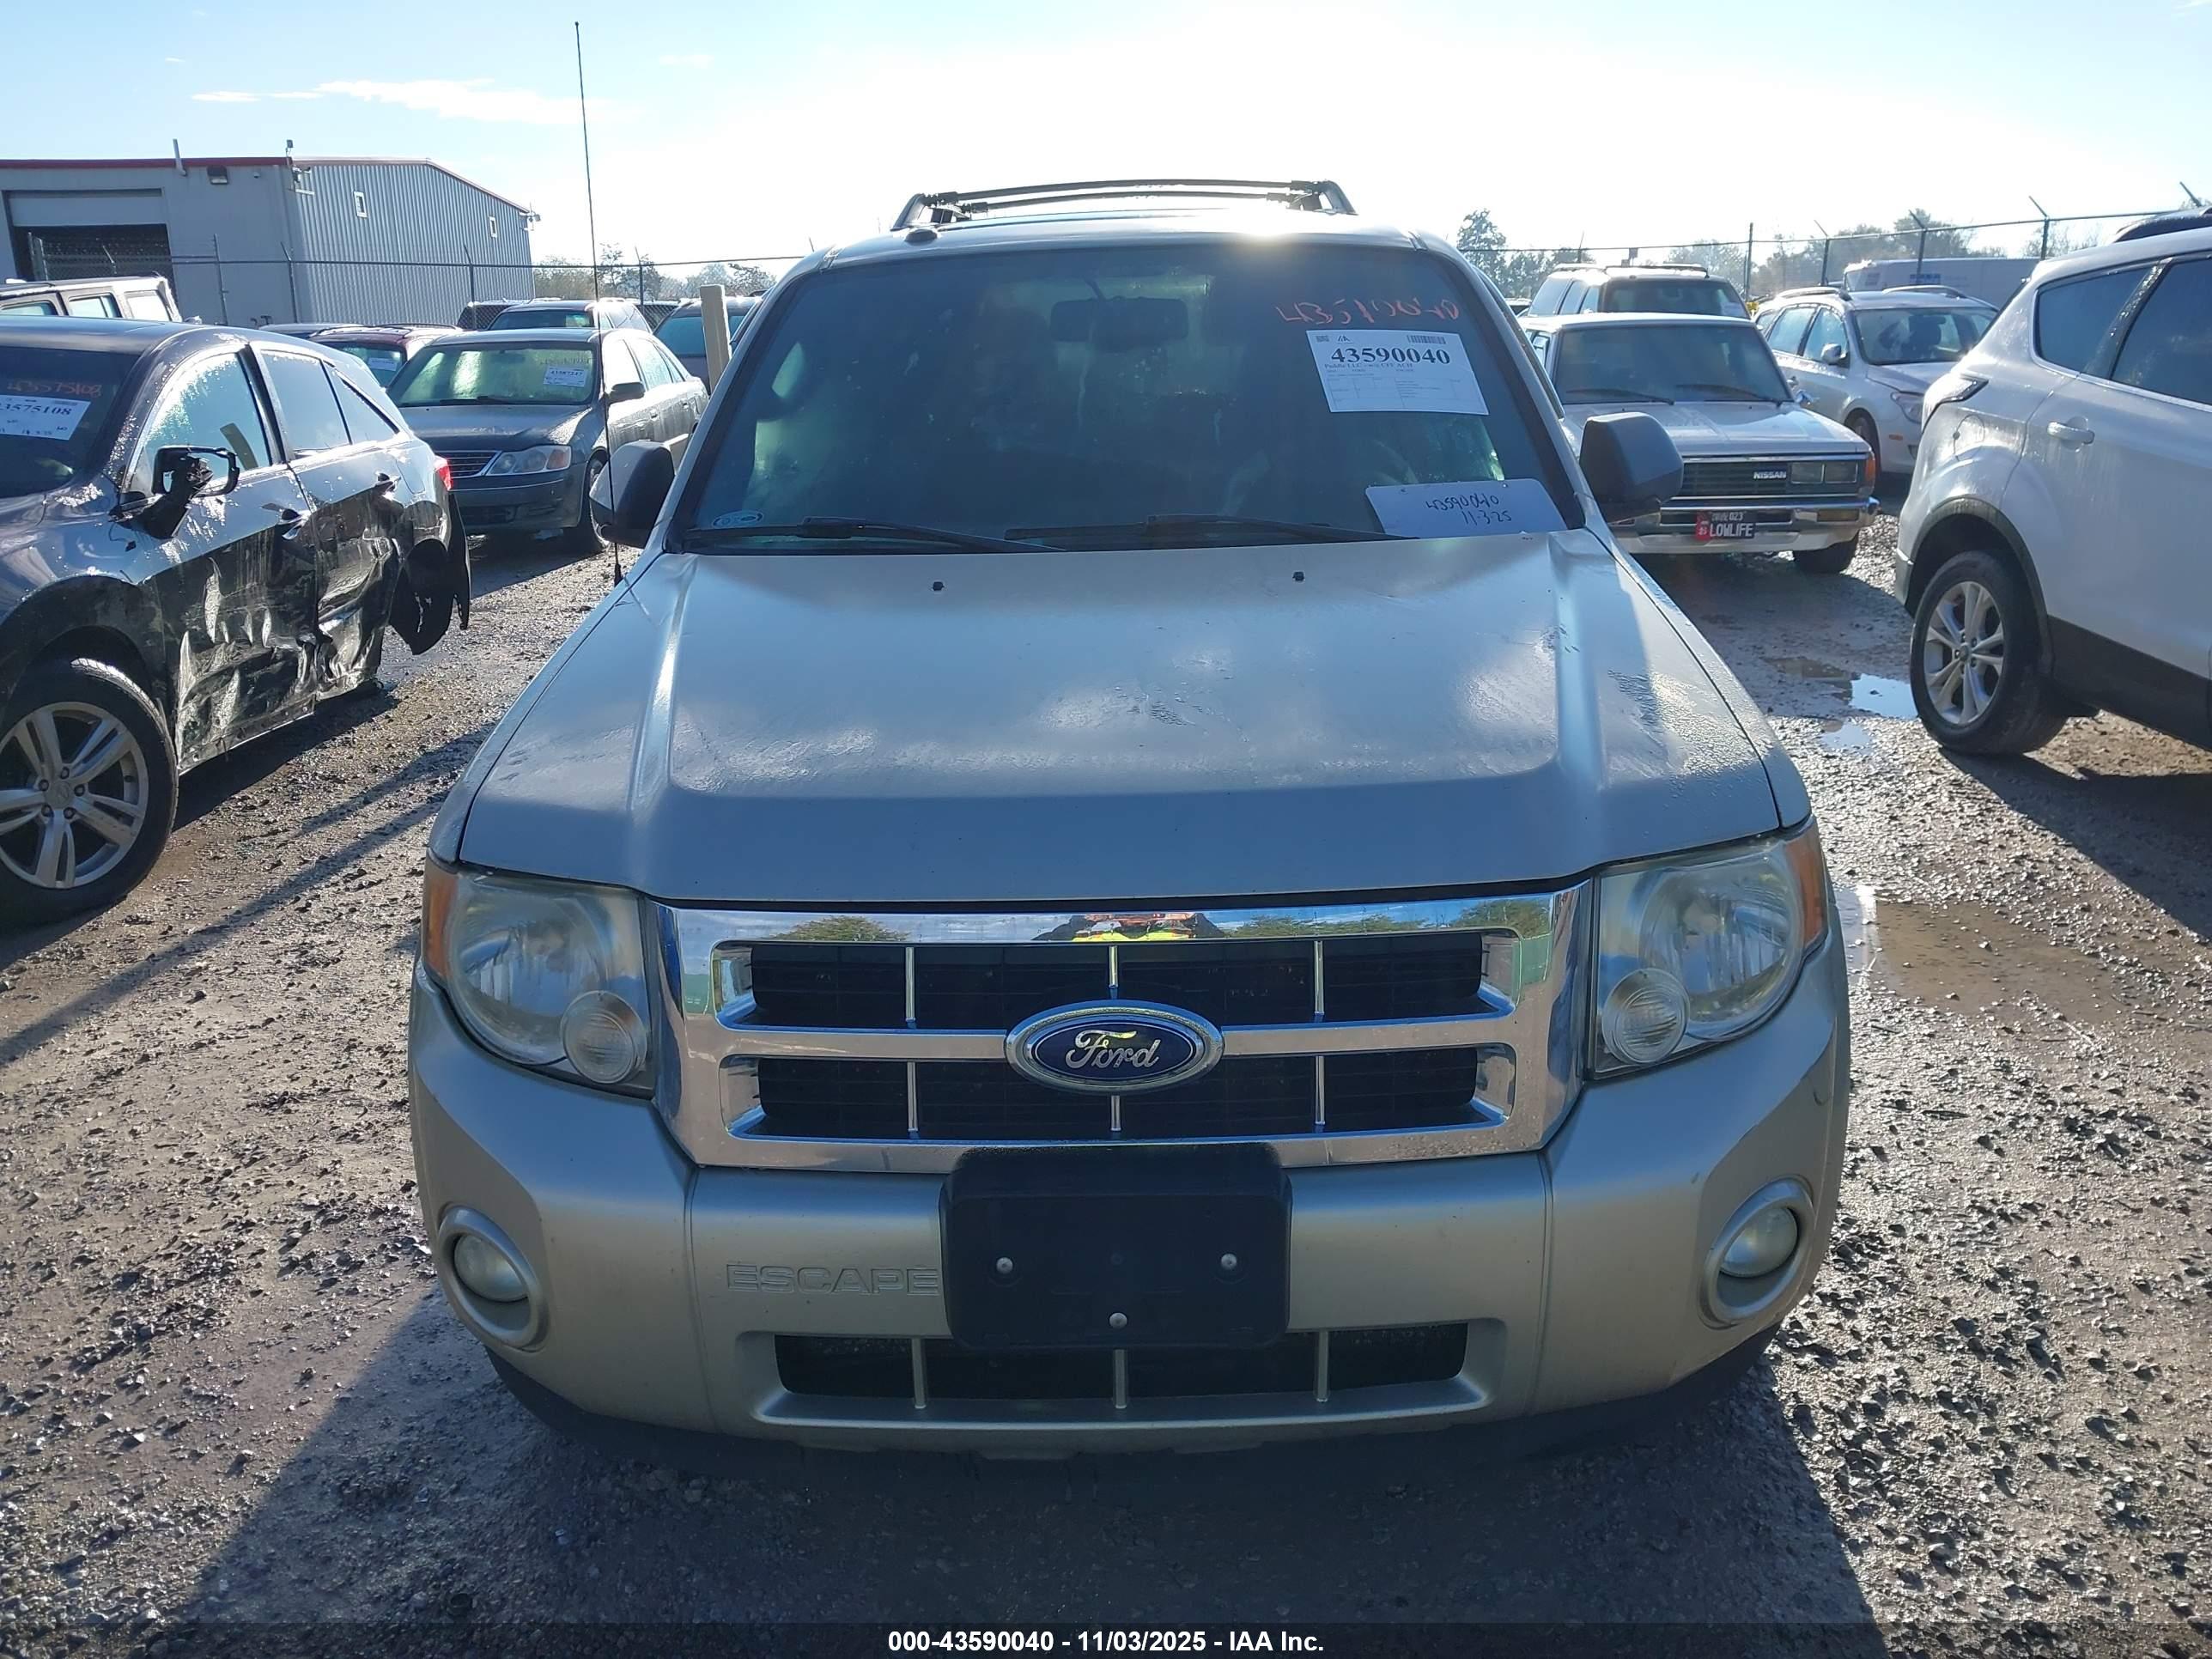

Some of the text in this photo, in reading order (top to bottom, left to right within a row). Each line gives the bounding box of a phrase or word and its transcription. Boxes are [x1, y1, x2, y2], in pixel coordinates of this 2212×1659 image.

[1331, 347, 1450, 365] 43590040
[0, 403, 72, 415] 3575108
[1425, 493, 1499, 511] 43590040
[1710, 522, 1754, 537] LOWLIFE
[1065, 1030, 1161, 1068] Ford
[726, 1263, 941, 1296] ESCAPE
